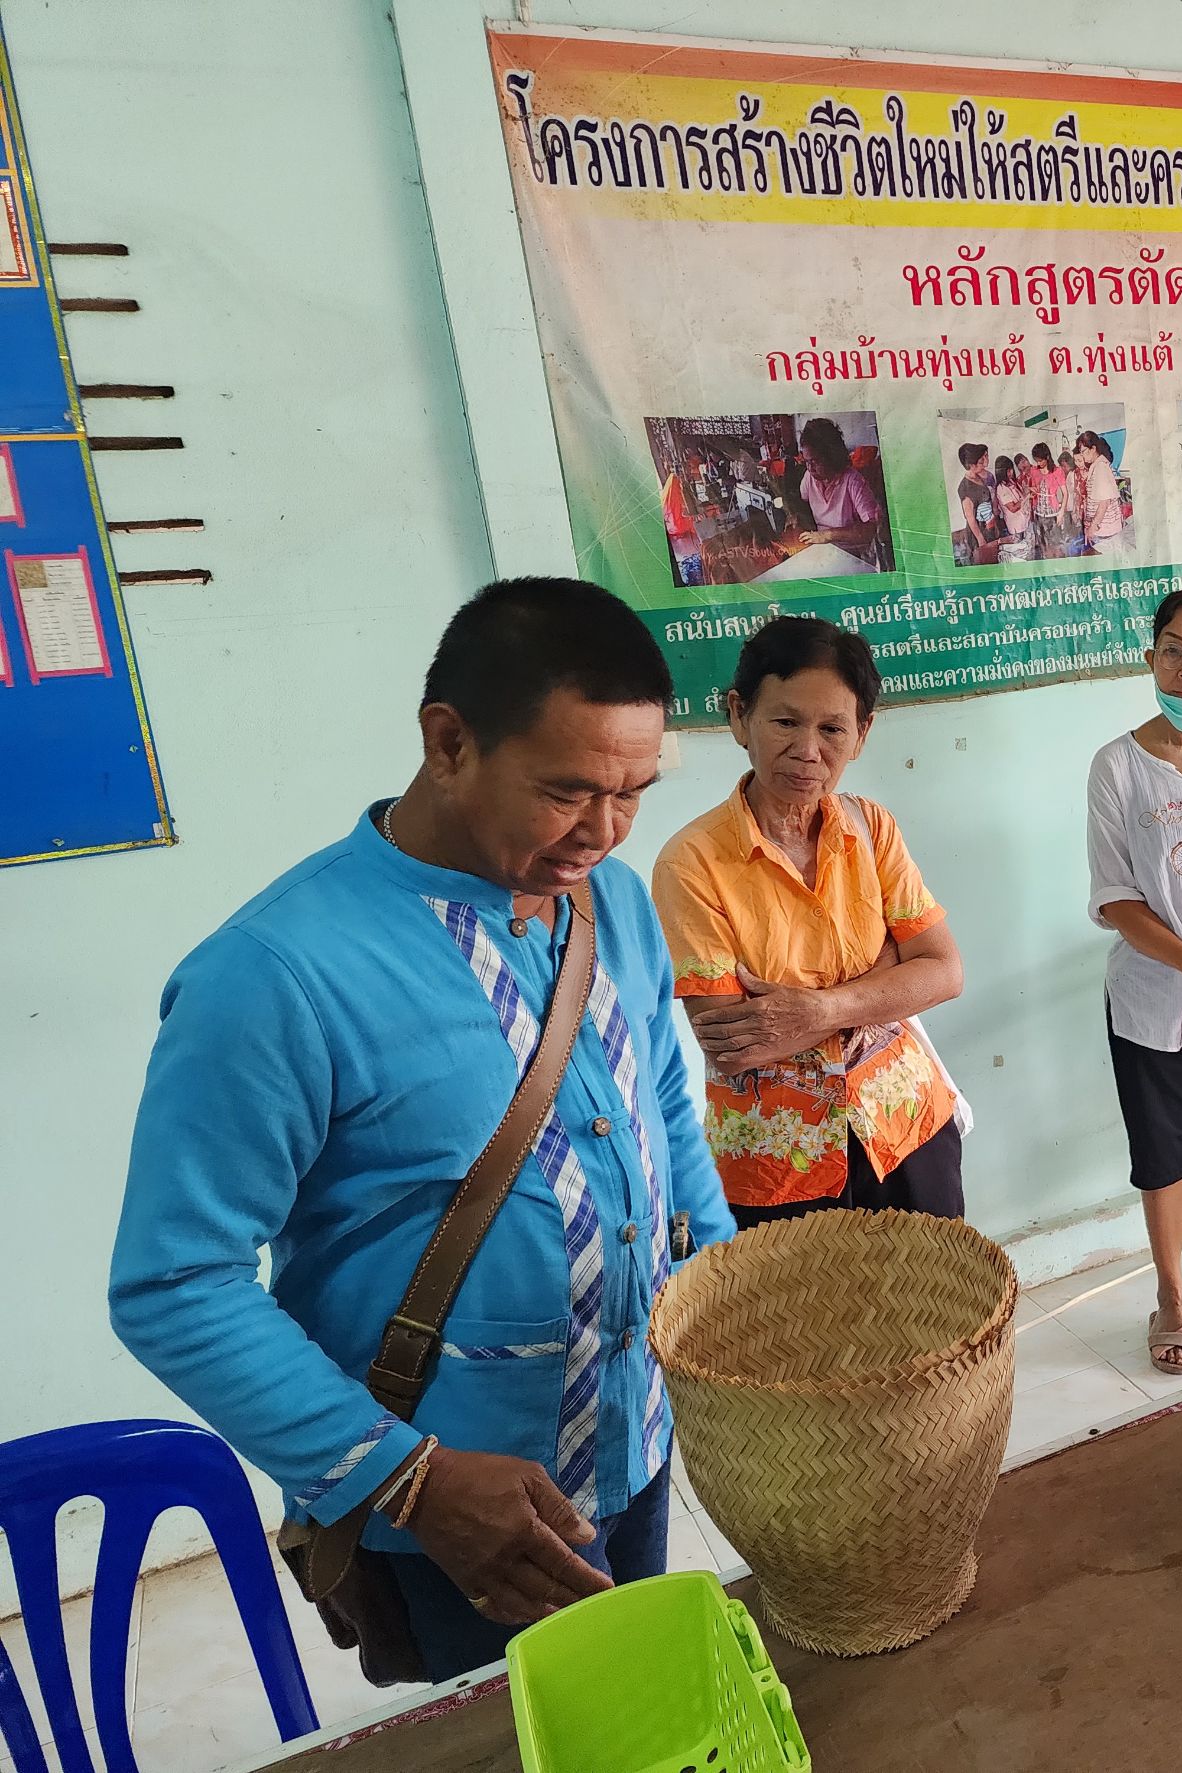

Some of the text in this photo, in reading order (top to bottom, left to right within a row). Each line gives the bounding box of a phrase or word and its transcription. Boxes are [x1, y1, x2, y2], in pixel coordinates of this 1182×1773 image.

[766, 335, 1027, 395] กลุ่มบ้านทุ่งแต้
[1049, 332, 1173, 386] ต.ทุ่งแต้
